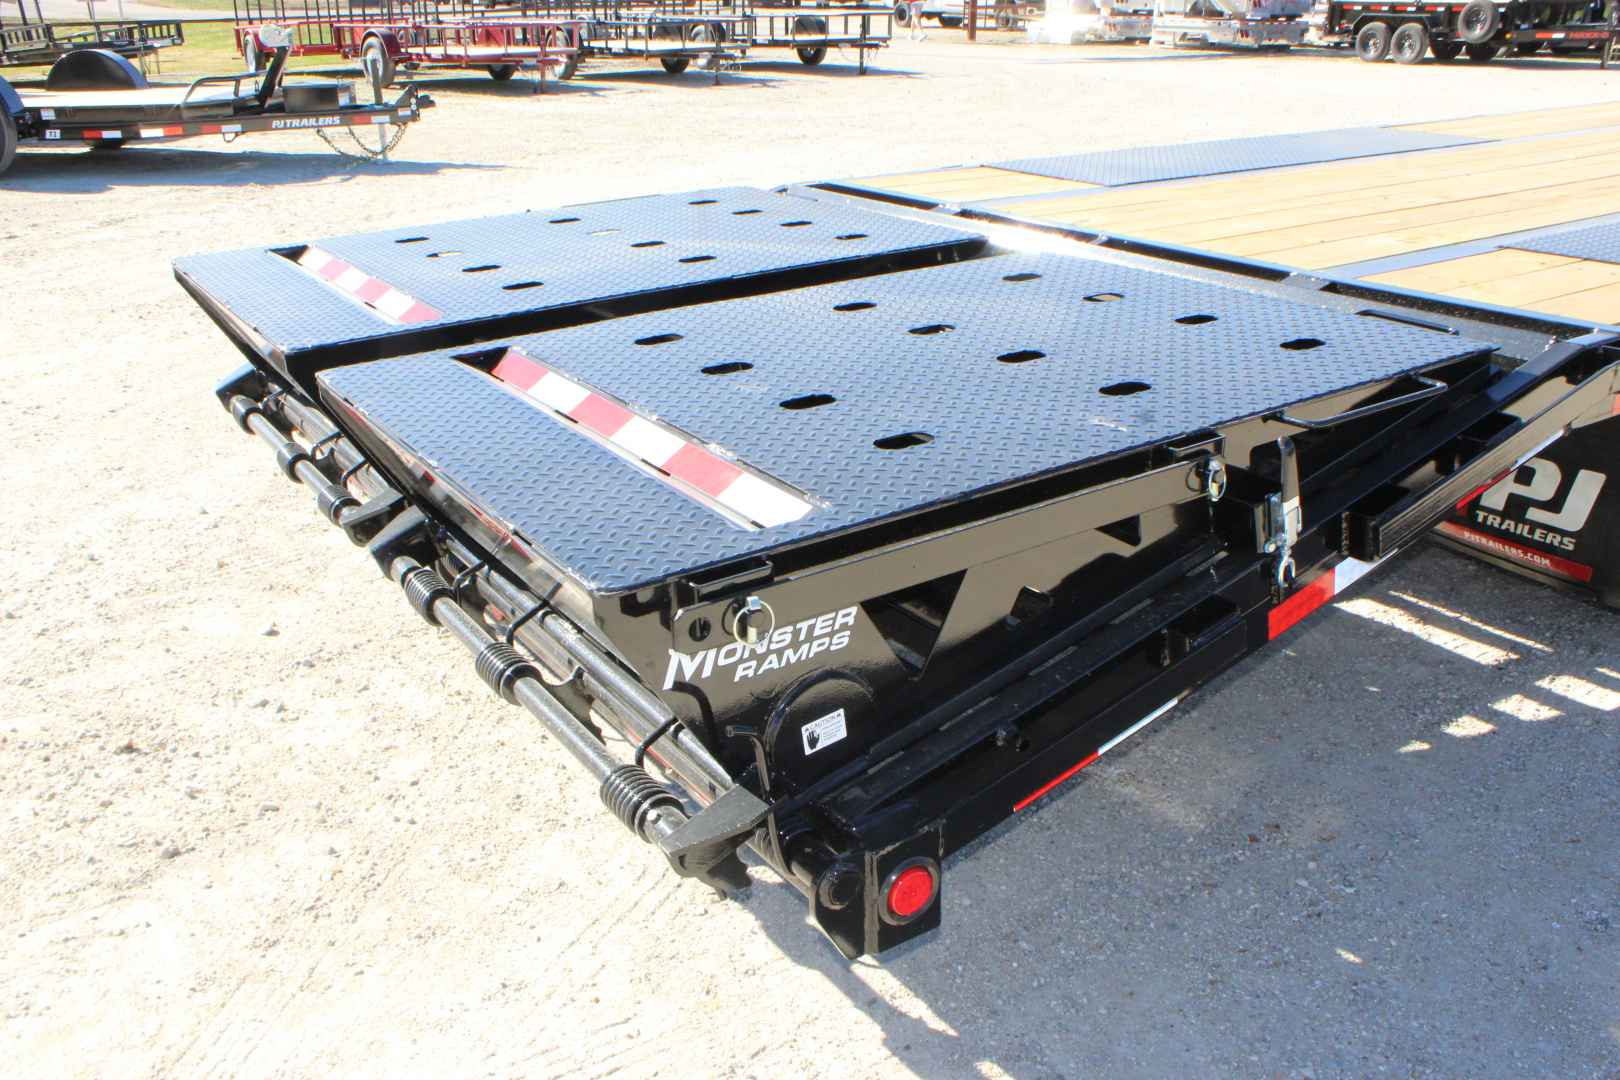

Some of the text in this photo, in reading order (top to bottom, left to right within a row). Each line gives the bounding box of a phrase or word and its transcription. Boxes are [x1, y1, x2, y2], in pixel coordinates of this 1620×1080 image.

[285, 116, 341, 128] TRAILERS
[1479, 456, 1607, 532] PJ
[1475, 510, 1577, 551] TRAILERS
[662, 605, 858, 691] MONSTER
[733, 630, 851, 683] RAMPS
[809, 714, 836, 730] CAUTION
